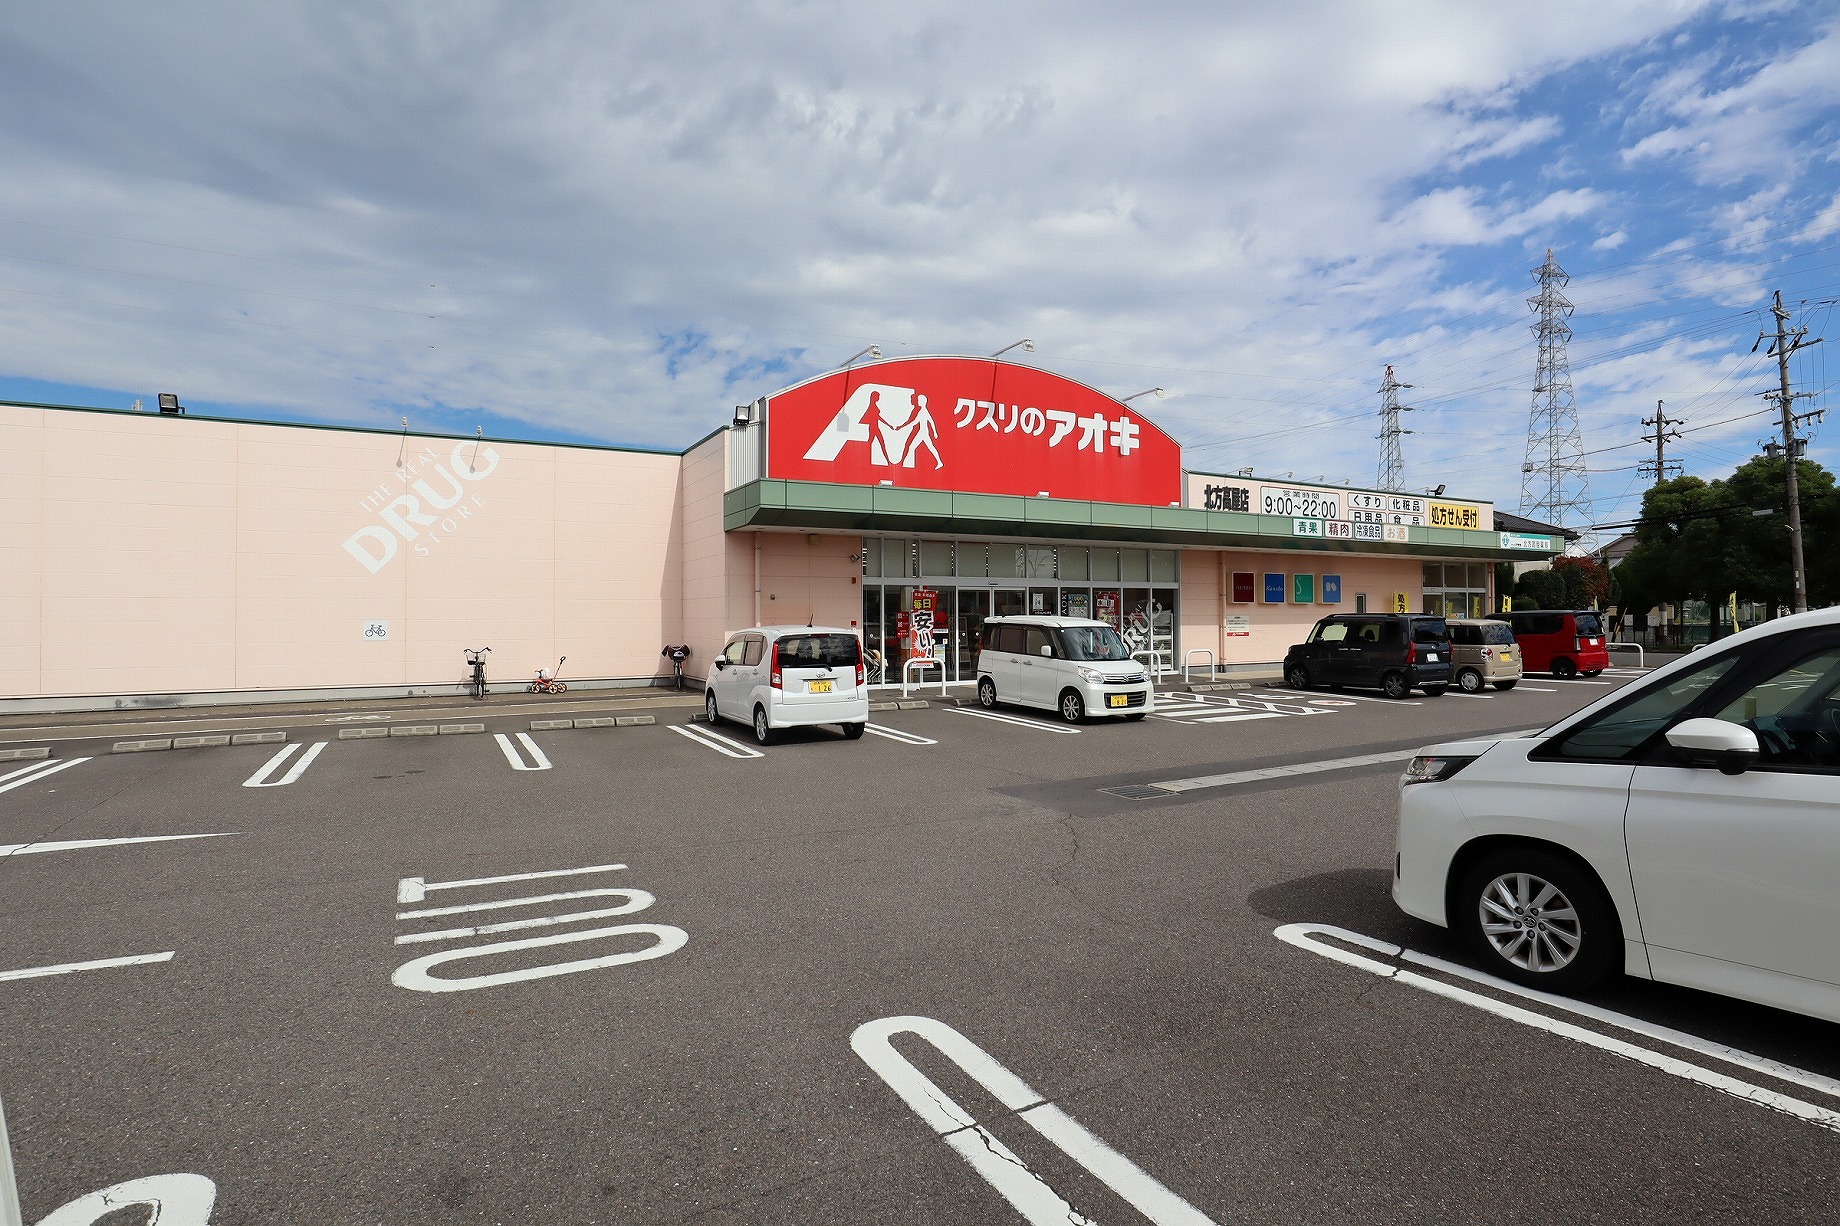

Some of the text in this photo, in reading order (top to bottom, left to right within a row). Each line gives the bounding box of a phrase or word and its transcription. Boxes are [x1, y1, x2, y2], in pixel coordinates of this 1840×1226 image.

[954, 397, 1140, 456] クスリのアオキ
[358, 446, 439, 512] THE REAL
[1204, 484, 1249, 512] 北方高屋店
[1283, 490, 1320, 500] 営業時間
[1353, 495, 1381, 507] くすり
[341, 440, 500, 574] DRUG
[1392, 498, 1420, 511] 化粧品
[1432, 505, 1477, 528] 処方せん受付
[414, 492, 486, 558] STORE
[1298, 521, 1318, 534] 青果
[1328, 522, 1349, 536] 精肉
[1356, 524, 1381, 538] 冷凍食品
[1387, 526, 1406, 540] お酒
[913, 599, 932, 610] 毎日
